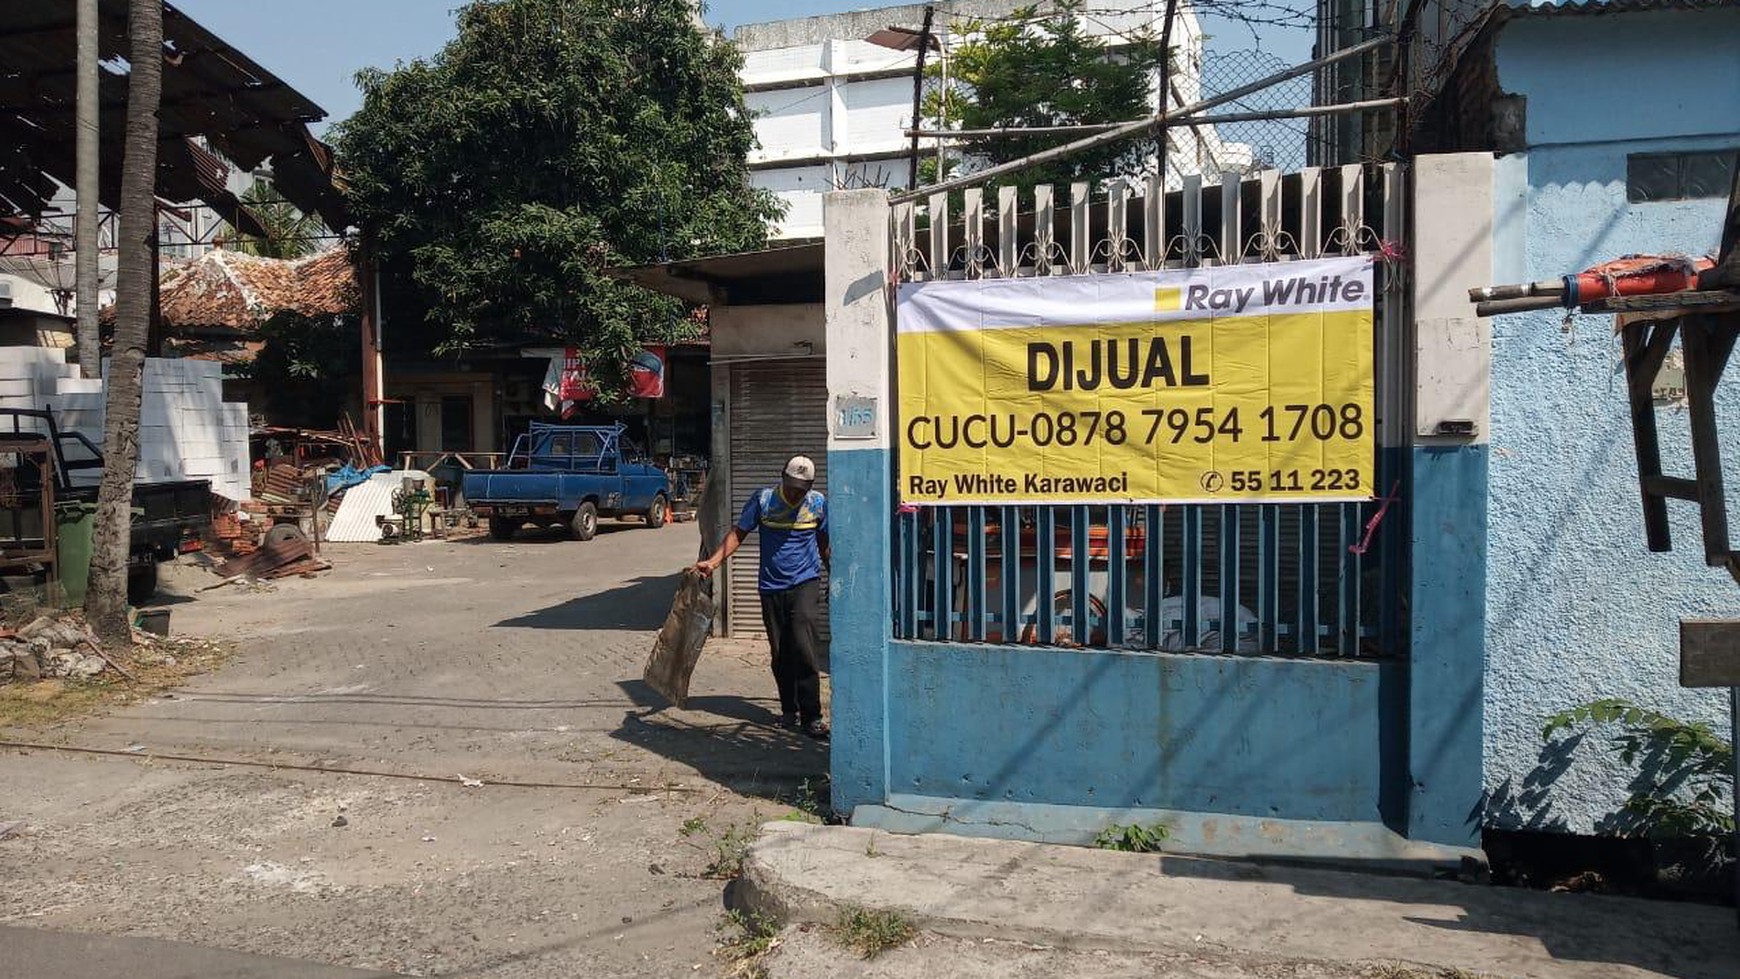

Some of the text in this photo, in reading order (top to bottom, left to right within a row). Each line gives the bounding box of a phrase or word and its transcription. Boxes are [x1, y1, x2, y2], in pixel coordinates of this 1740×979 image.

[1185, 275, 1364, 314] Ray White
[1026, 336, 1209, 391] DIJUAL
[908, 402, 1363, 449] CUCU-0878 7954 1708
[909, 471, 1128, 498] Ray White Karawaci
[1231, 468, 1360, 492] 55 11 223
